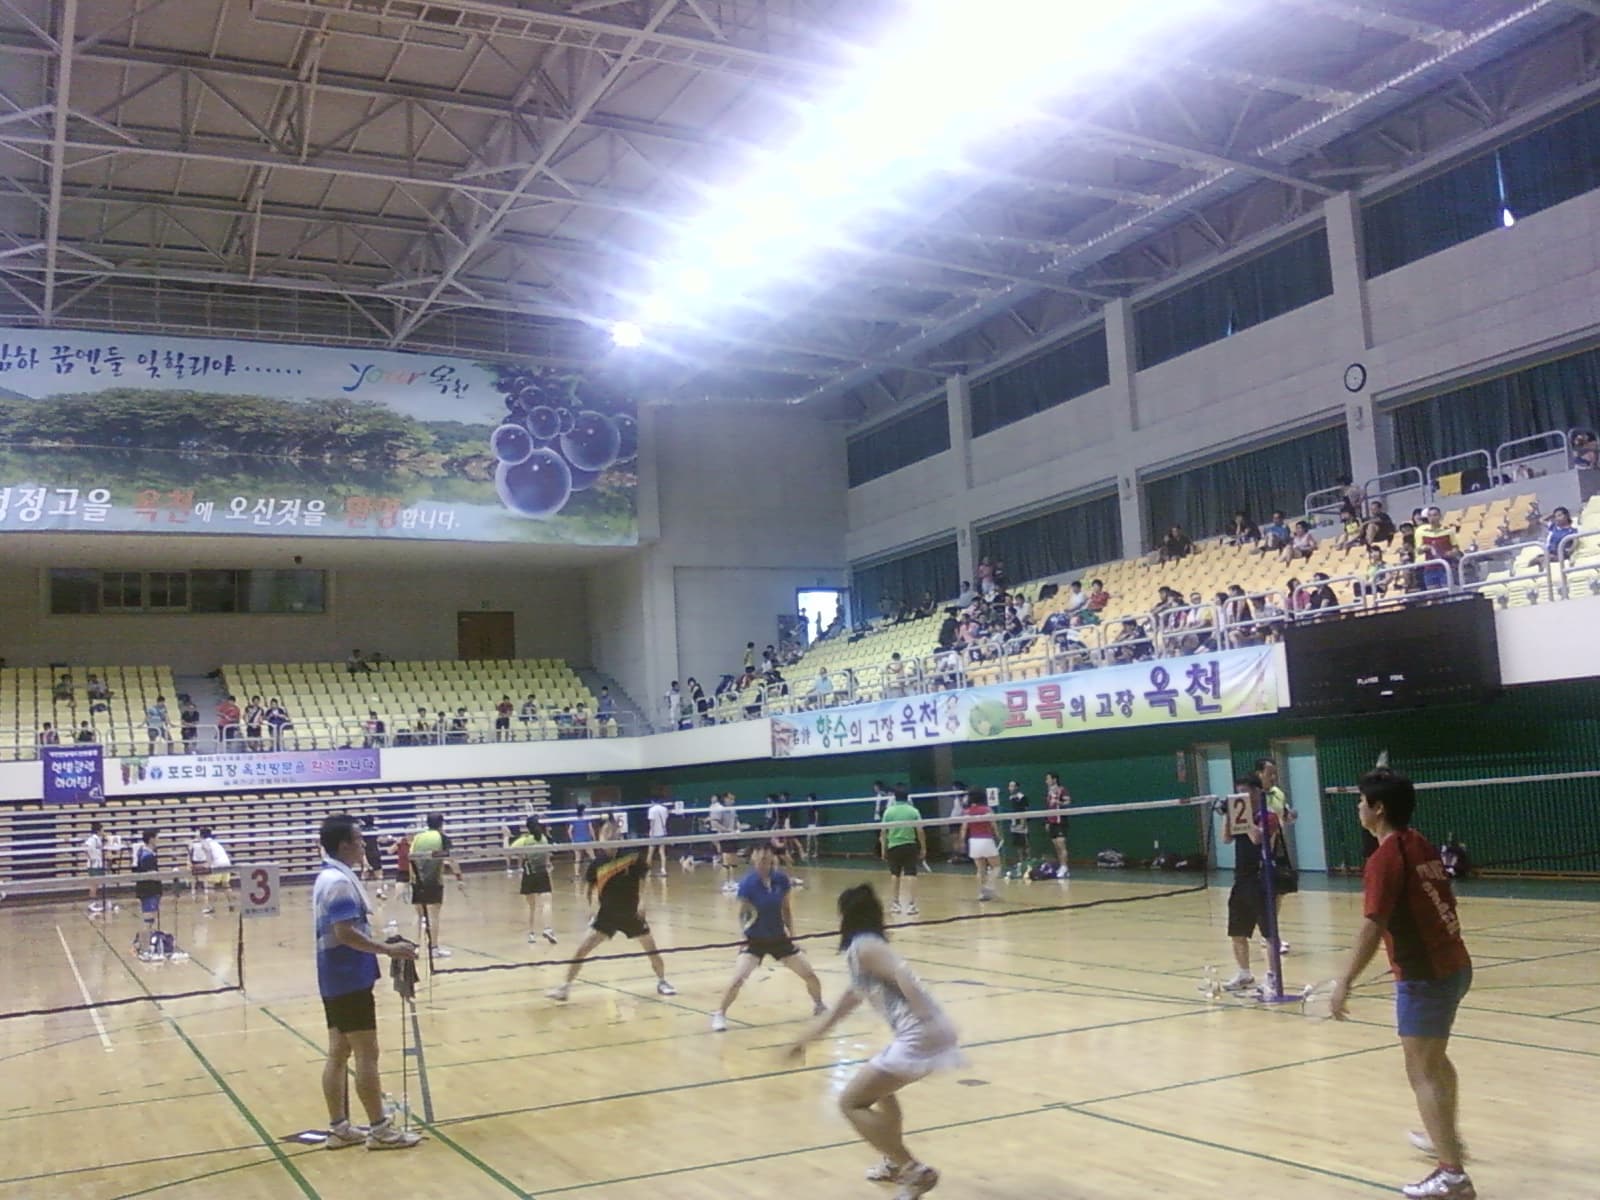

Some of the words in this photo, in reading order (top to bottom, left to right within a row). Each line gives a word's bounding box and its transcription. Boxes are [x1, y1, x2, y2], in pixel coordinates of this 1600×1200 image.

[50, 345, 126, 377] 꿈엔들
[134, 489, 214, 525] 옥천에
[225, 496, 328, 527] 오신것을
[1005, 683, 1087, 729] 묘목의
[1095, 689, 1136, 718] 고장
[1143, 660, 1223, 717] 옥천
[816, 714, 863, 749] 향수의
[867, 714, 895, 743] 고장
[900, 700, 940, 740] 옥천
[167, 764, 207, 779] 포도의
[211, 763, 238, 778] 고장
[1233, 797, 1248, 825] 2
[250, 868, 271, 905] 3
